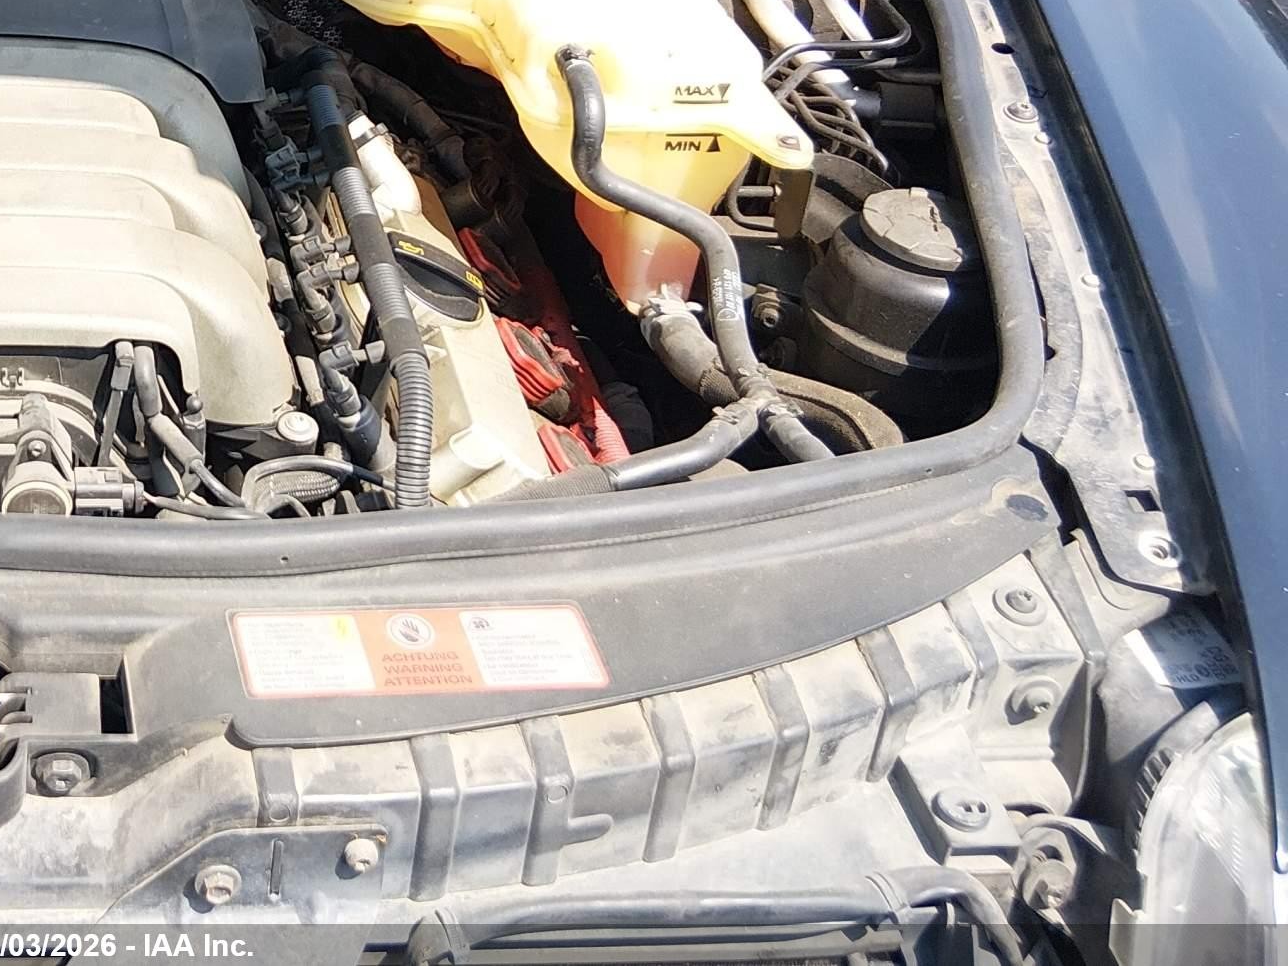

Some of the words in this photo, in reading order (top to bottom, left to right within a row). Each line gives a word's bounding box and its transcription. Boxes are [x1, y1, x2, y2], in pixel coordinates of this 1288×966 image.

[674, 85, 716, 96] MAX
[664, 140, 702, 152] MIN
[381, 650, 459, 663] ACHTUNG
[383, 662, 464, 675] WARNING
[383, 674, 473, 687] ATTENTION
